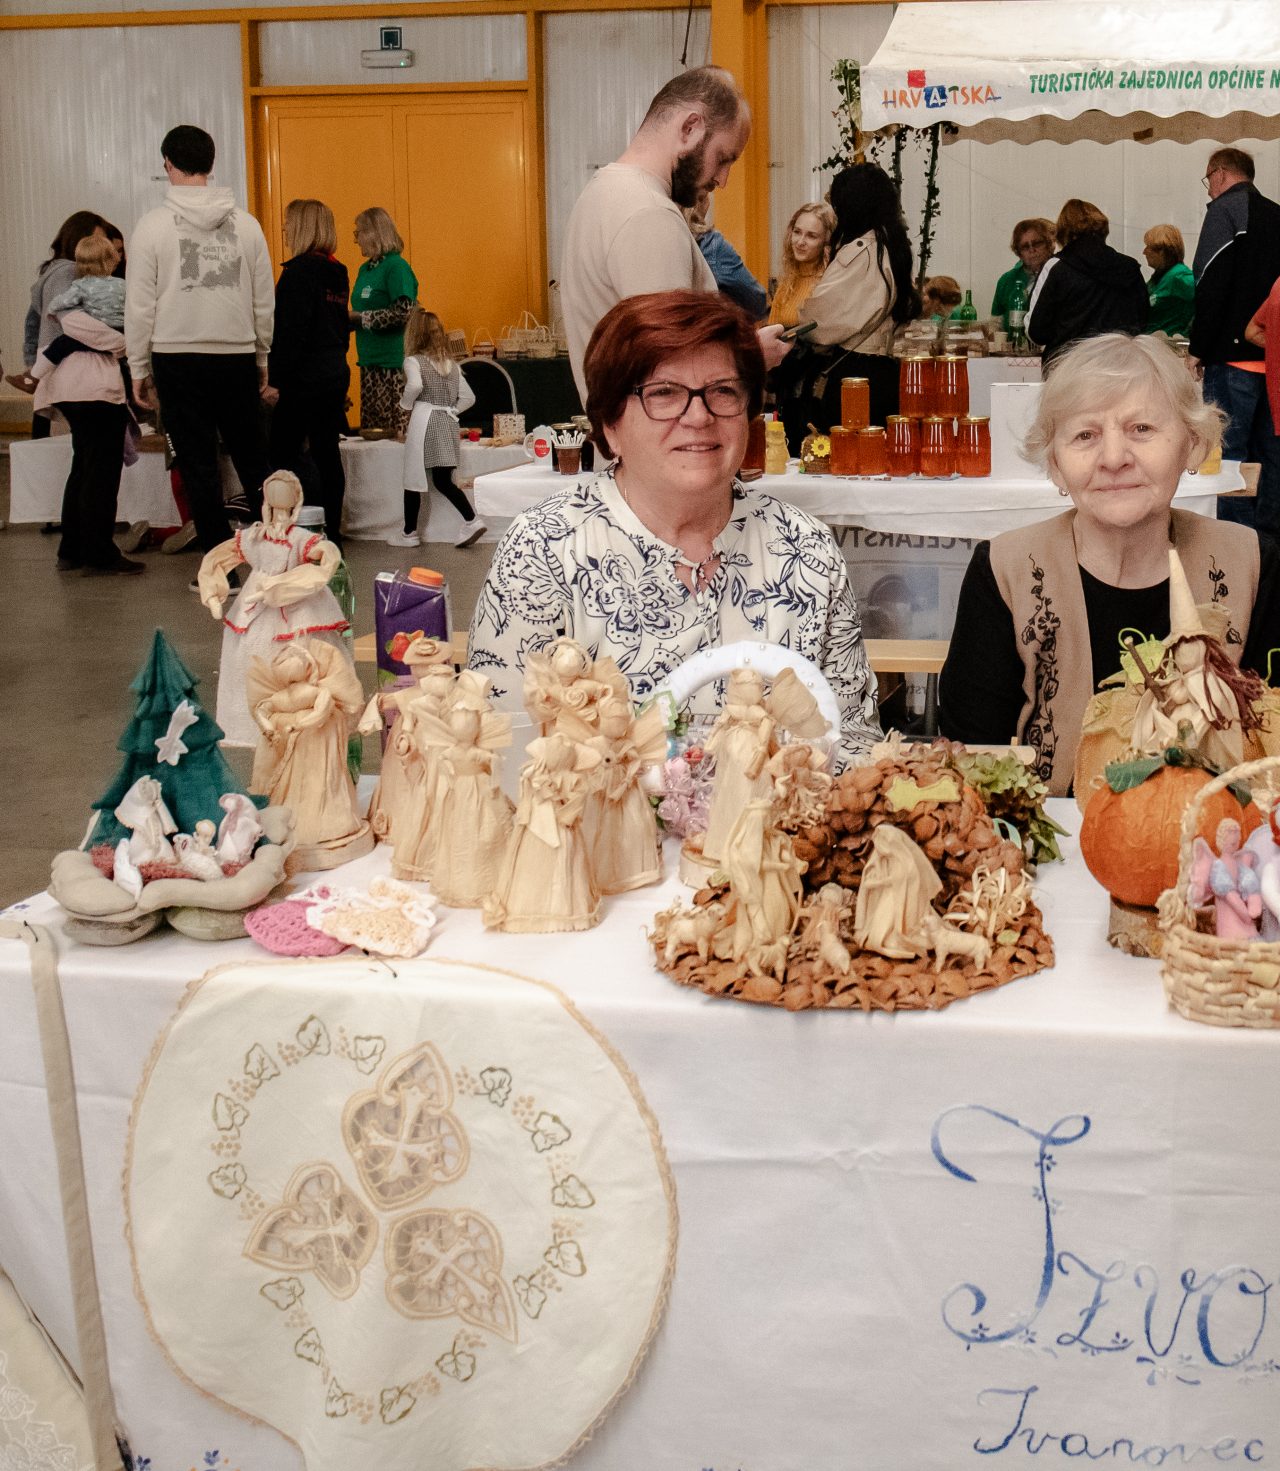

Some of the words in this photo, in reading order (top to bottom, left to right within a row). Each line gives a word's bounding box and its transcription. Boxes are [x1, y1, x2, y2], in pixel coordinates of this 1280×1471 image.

[1029, 68, 1114, 93] TURISTIČKA
[1118, 70, 1203, 89] ZAJEDNICA
[1208, 65, 1265, 89] OPĆINE
[882, 85, 1002, 109] HRVATSKA
[973, 1385, 1265, 1466] Ivanovec
